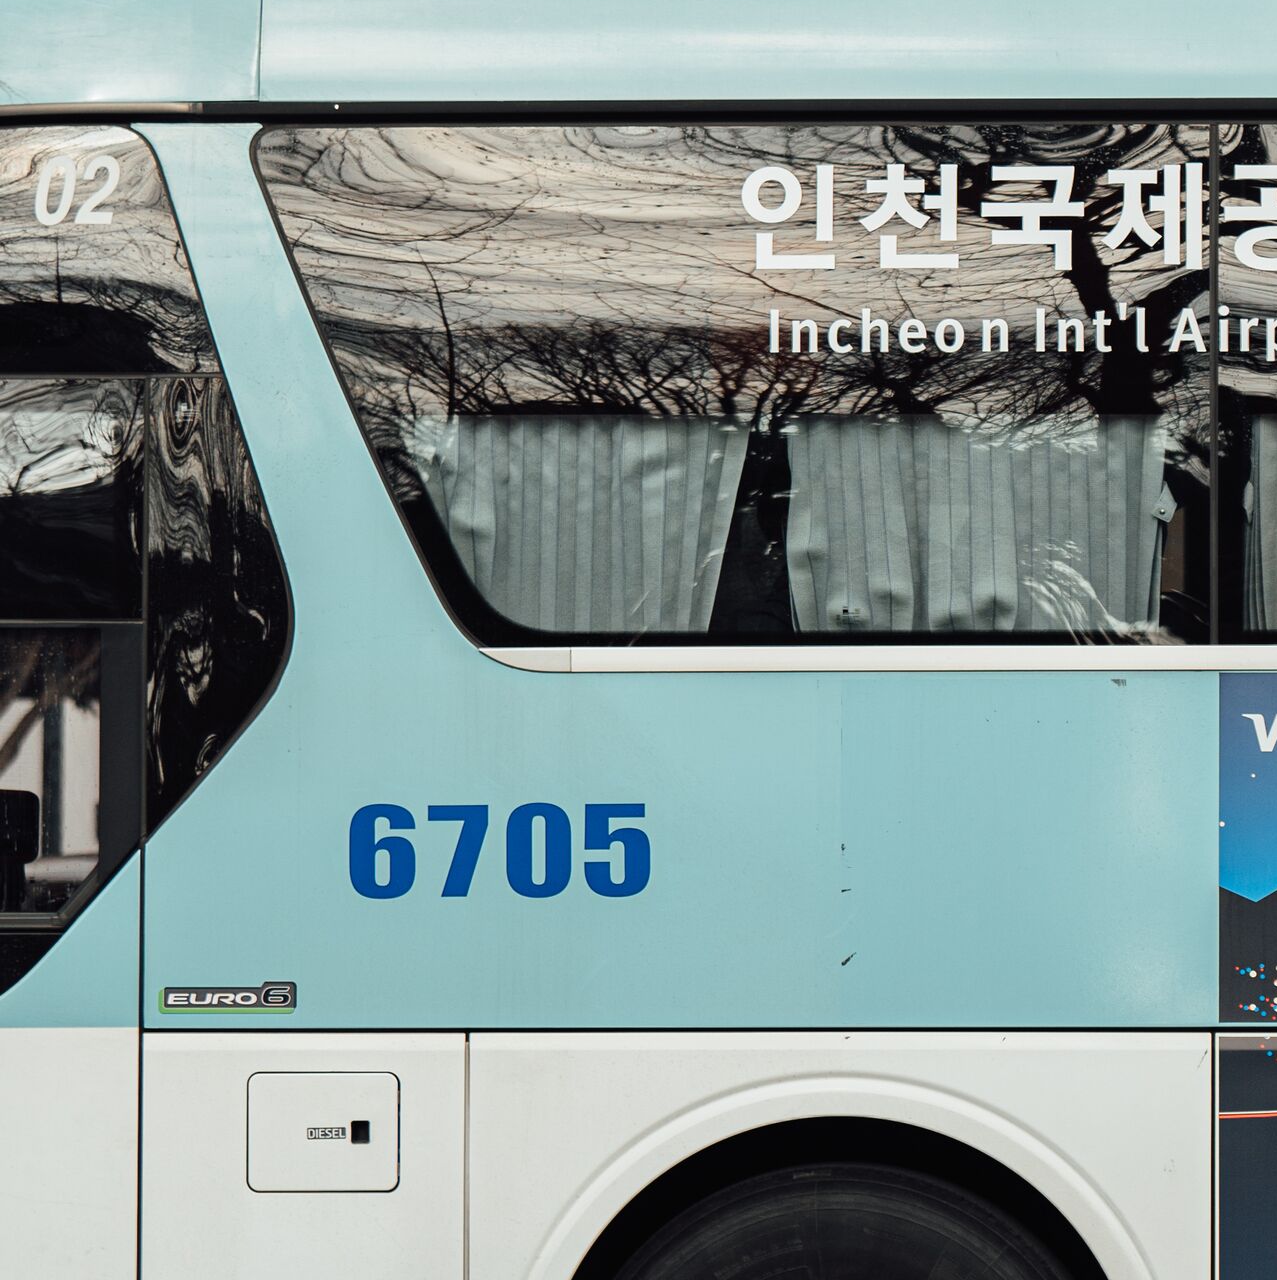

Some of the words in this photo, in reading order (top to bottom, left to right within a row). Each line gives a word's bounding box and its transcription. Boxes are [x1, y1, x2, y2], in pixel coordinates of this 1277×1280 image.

[35, 155, 120, 226] 02
[768, 308, 1011, 354] Incheon
[1036, 303, 1148, 353] Int'l
[348, 802, 651, 900] 6705
[308, 1128, 346, 1139] DIESEL
